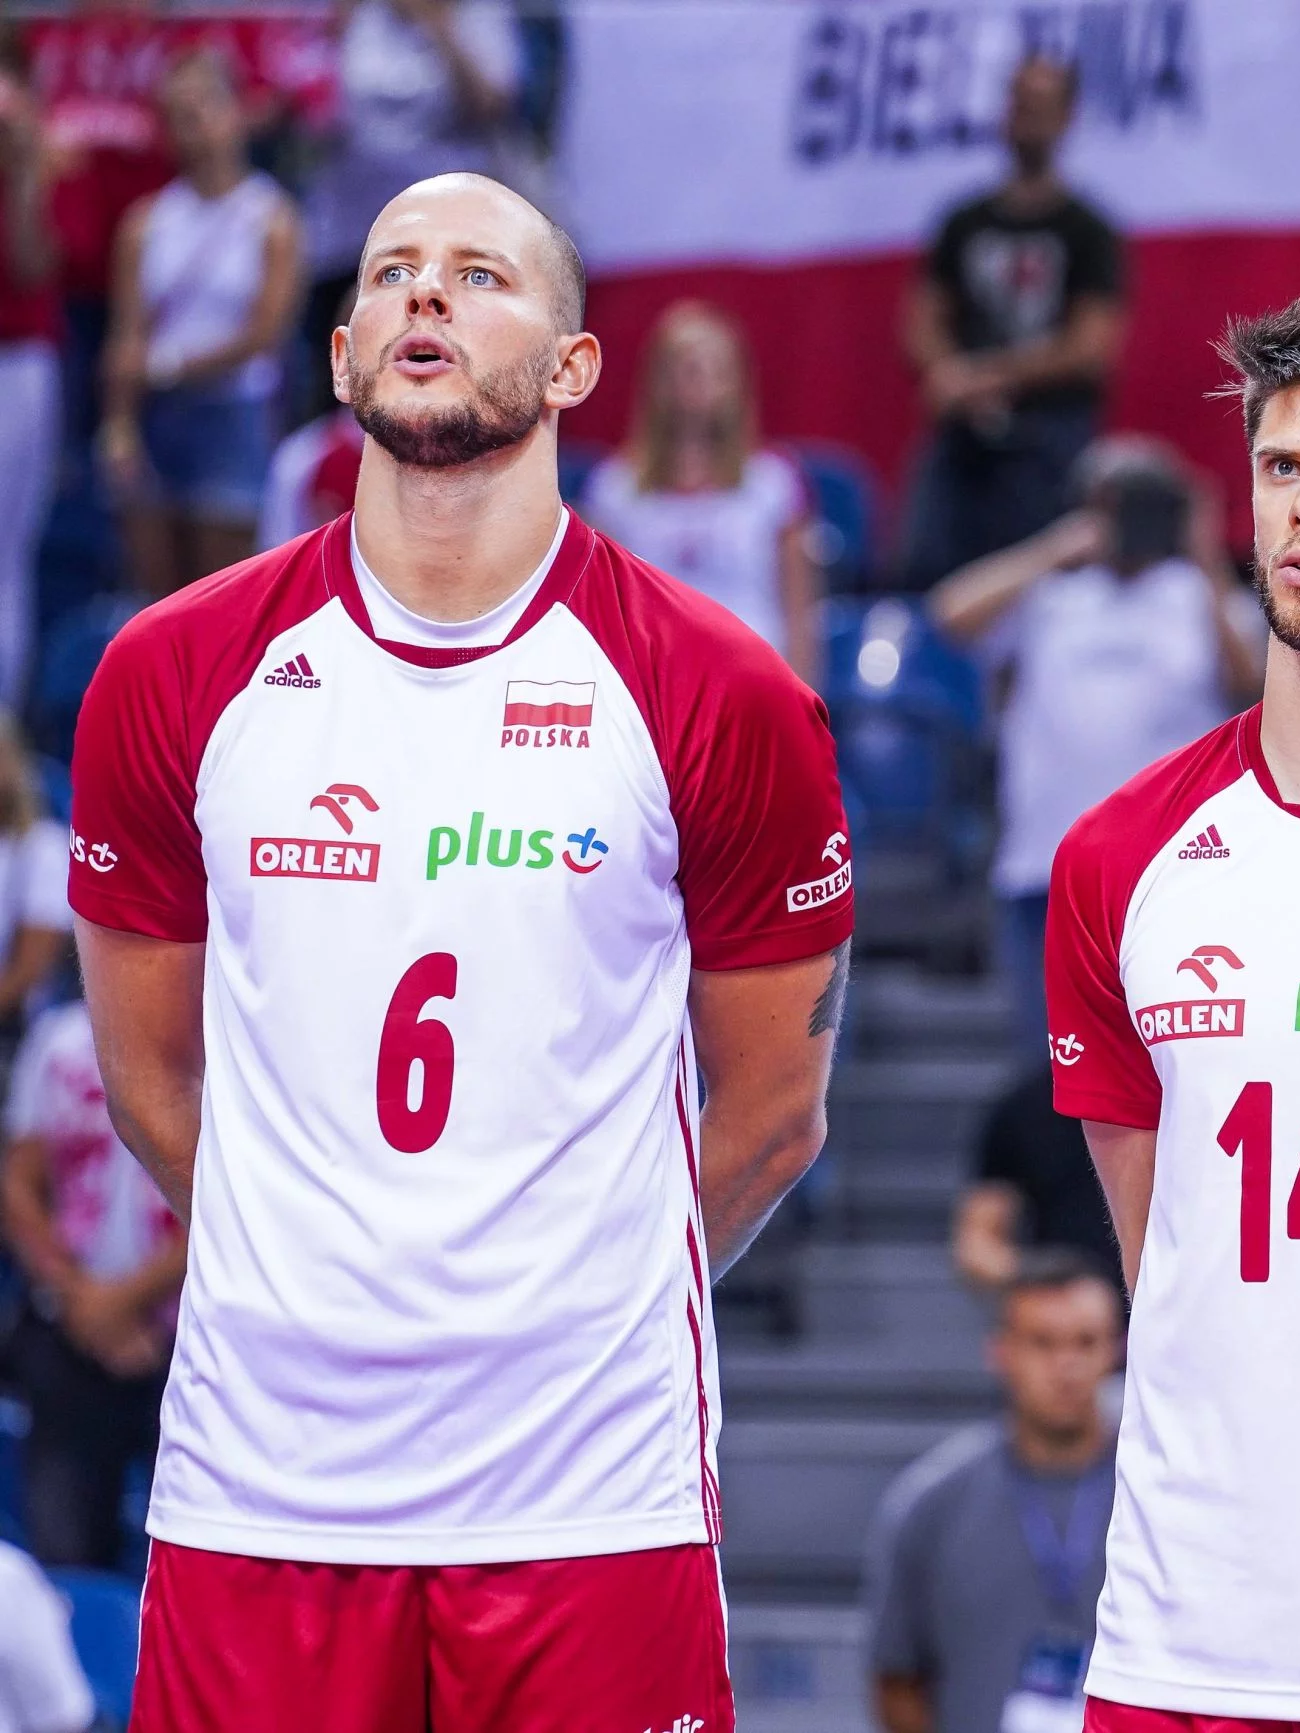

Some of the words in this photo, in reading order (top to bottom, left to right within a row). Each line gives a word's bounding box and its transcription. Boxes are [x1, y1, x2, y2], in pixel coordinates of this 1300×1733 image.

[264, 672, 322, 689] adidas
[501, 728, 590, 749] POLSKA
[255, 843, 371, 876] ORLEN
[426, 811, 554, 880] plus
[1178, 846, 1230, 860] adidas
[792, 866, 850, 907] ORLEN
[1140, 1005, 1237, 1040] ORLEN
[375, 951, 459, 1154] 6
